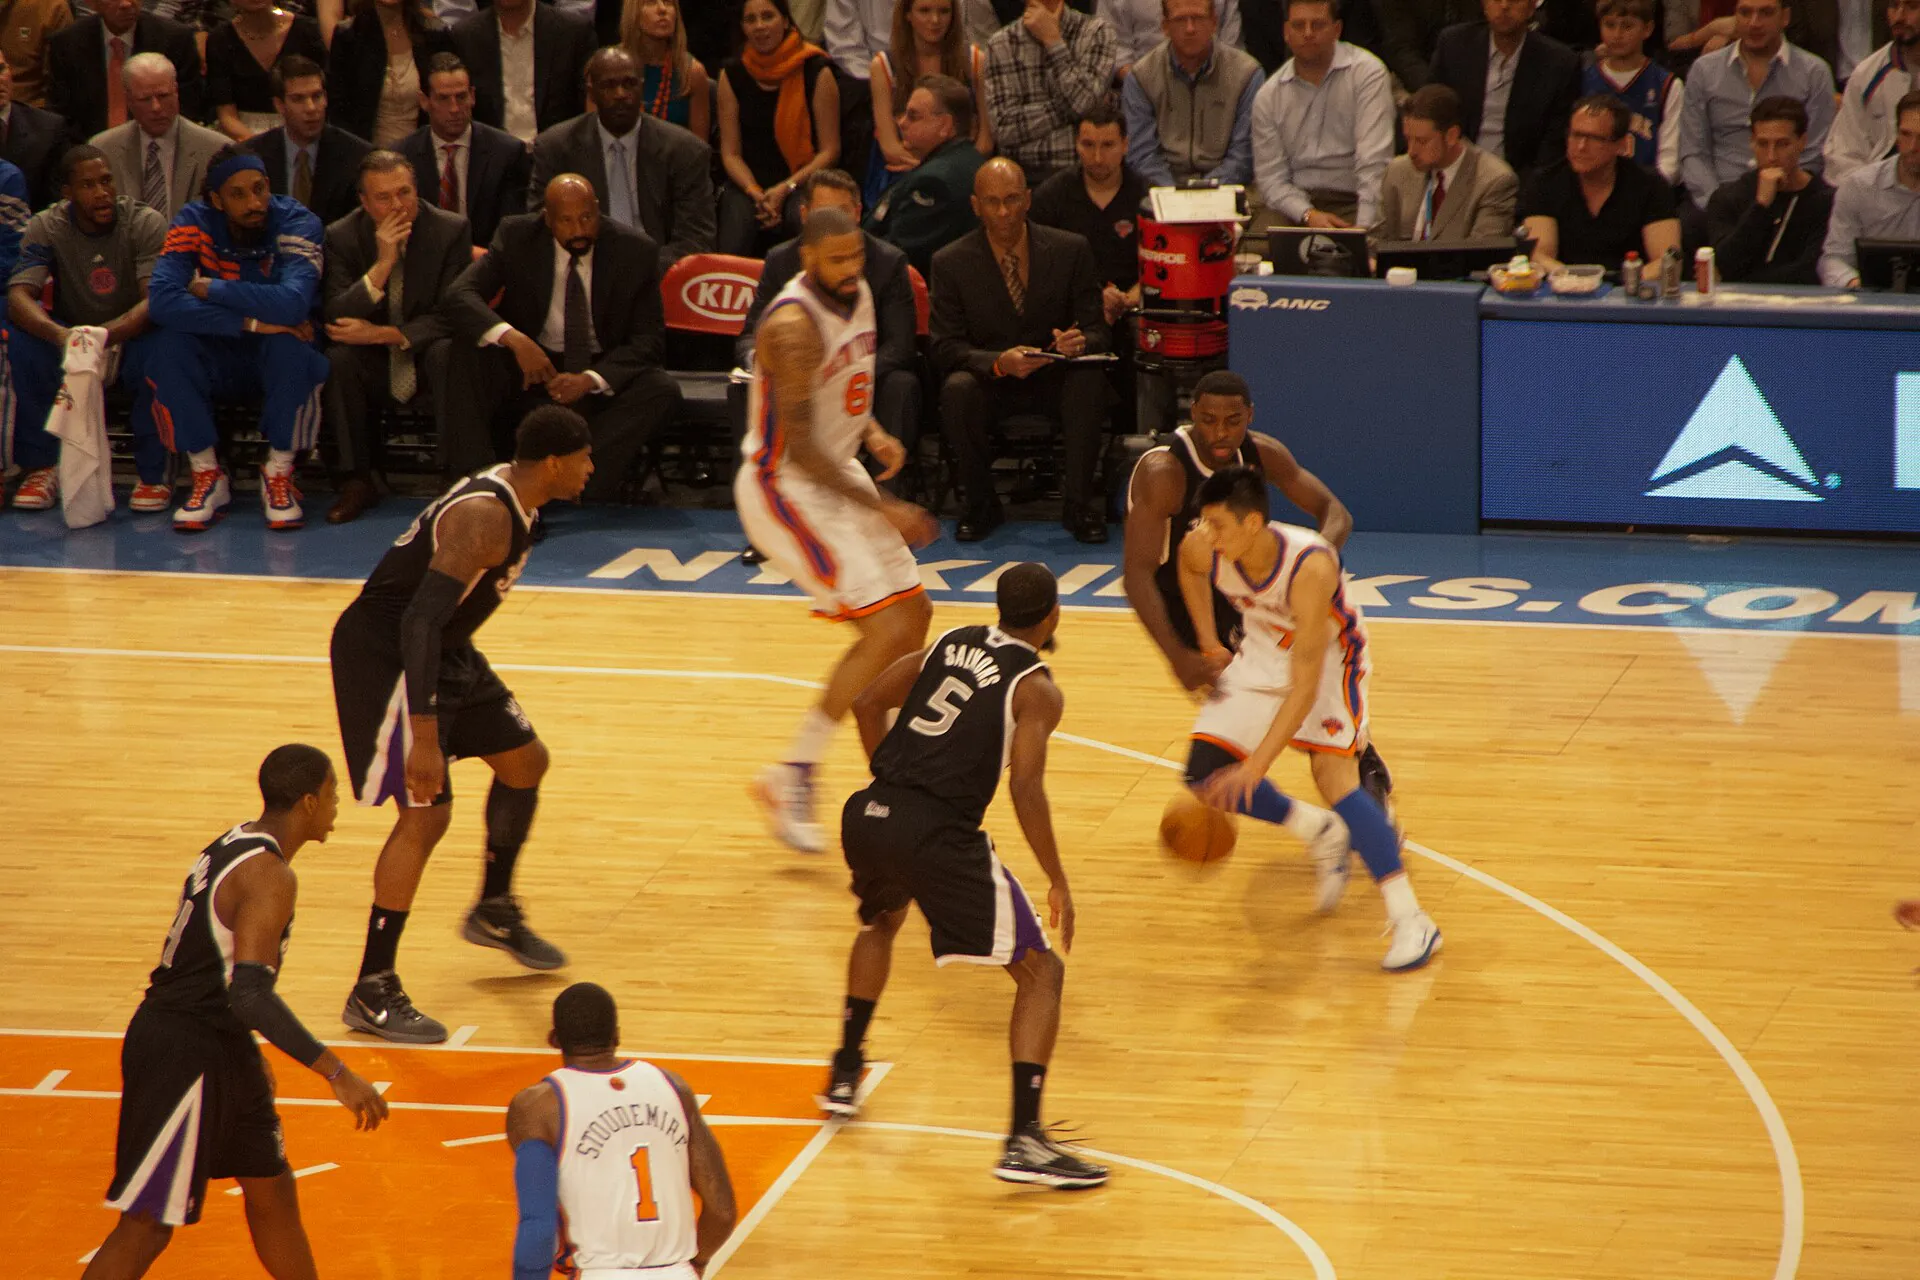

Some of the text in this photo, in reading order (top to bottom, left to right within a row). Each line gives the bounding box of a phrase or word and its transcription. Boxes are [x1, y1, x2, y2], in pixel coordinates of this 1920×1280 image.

[698, 282, 754, 310] KIA
[1269, 298, 1331, 311] ANC
[845, 371, 872, 416] 6
[944, 644, 1002, 689] SALMONS
[908, 676, 975, 736] 5
[630, 1145, 661, 1223] 1
